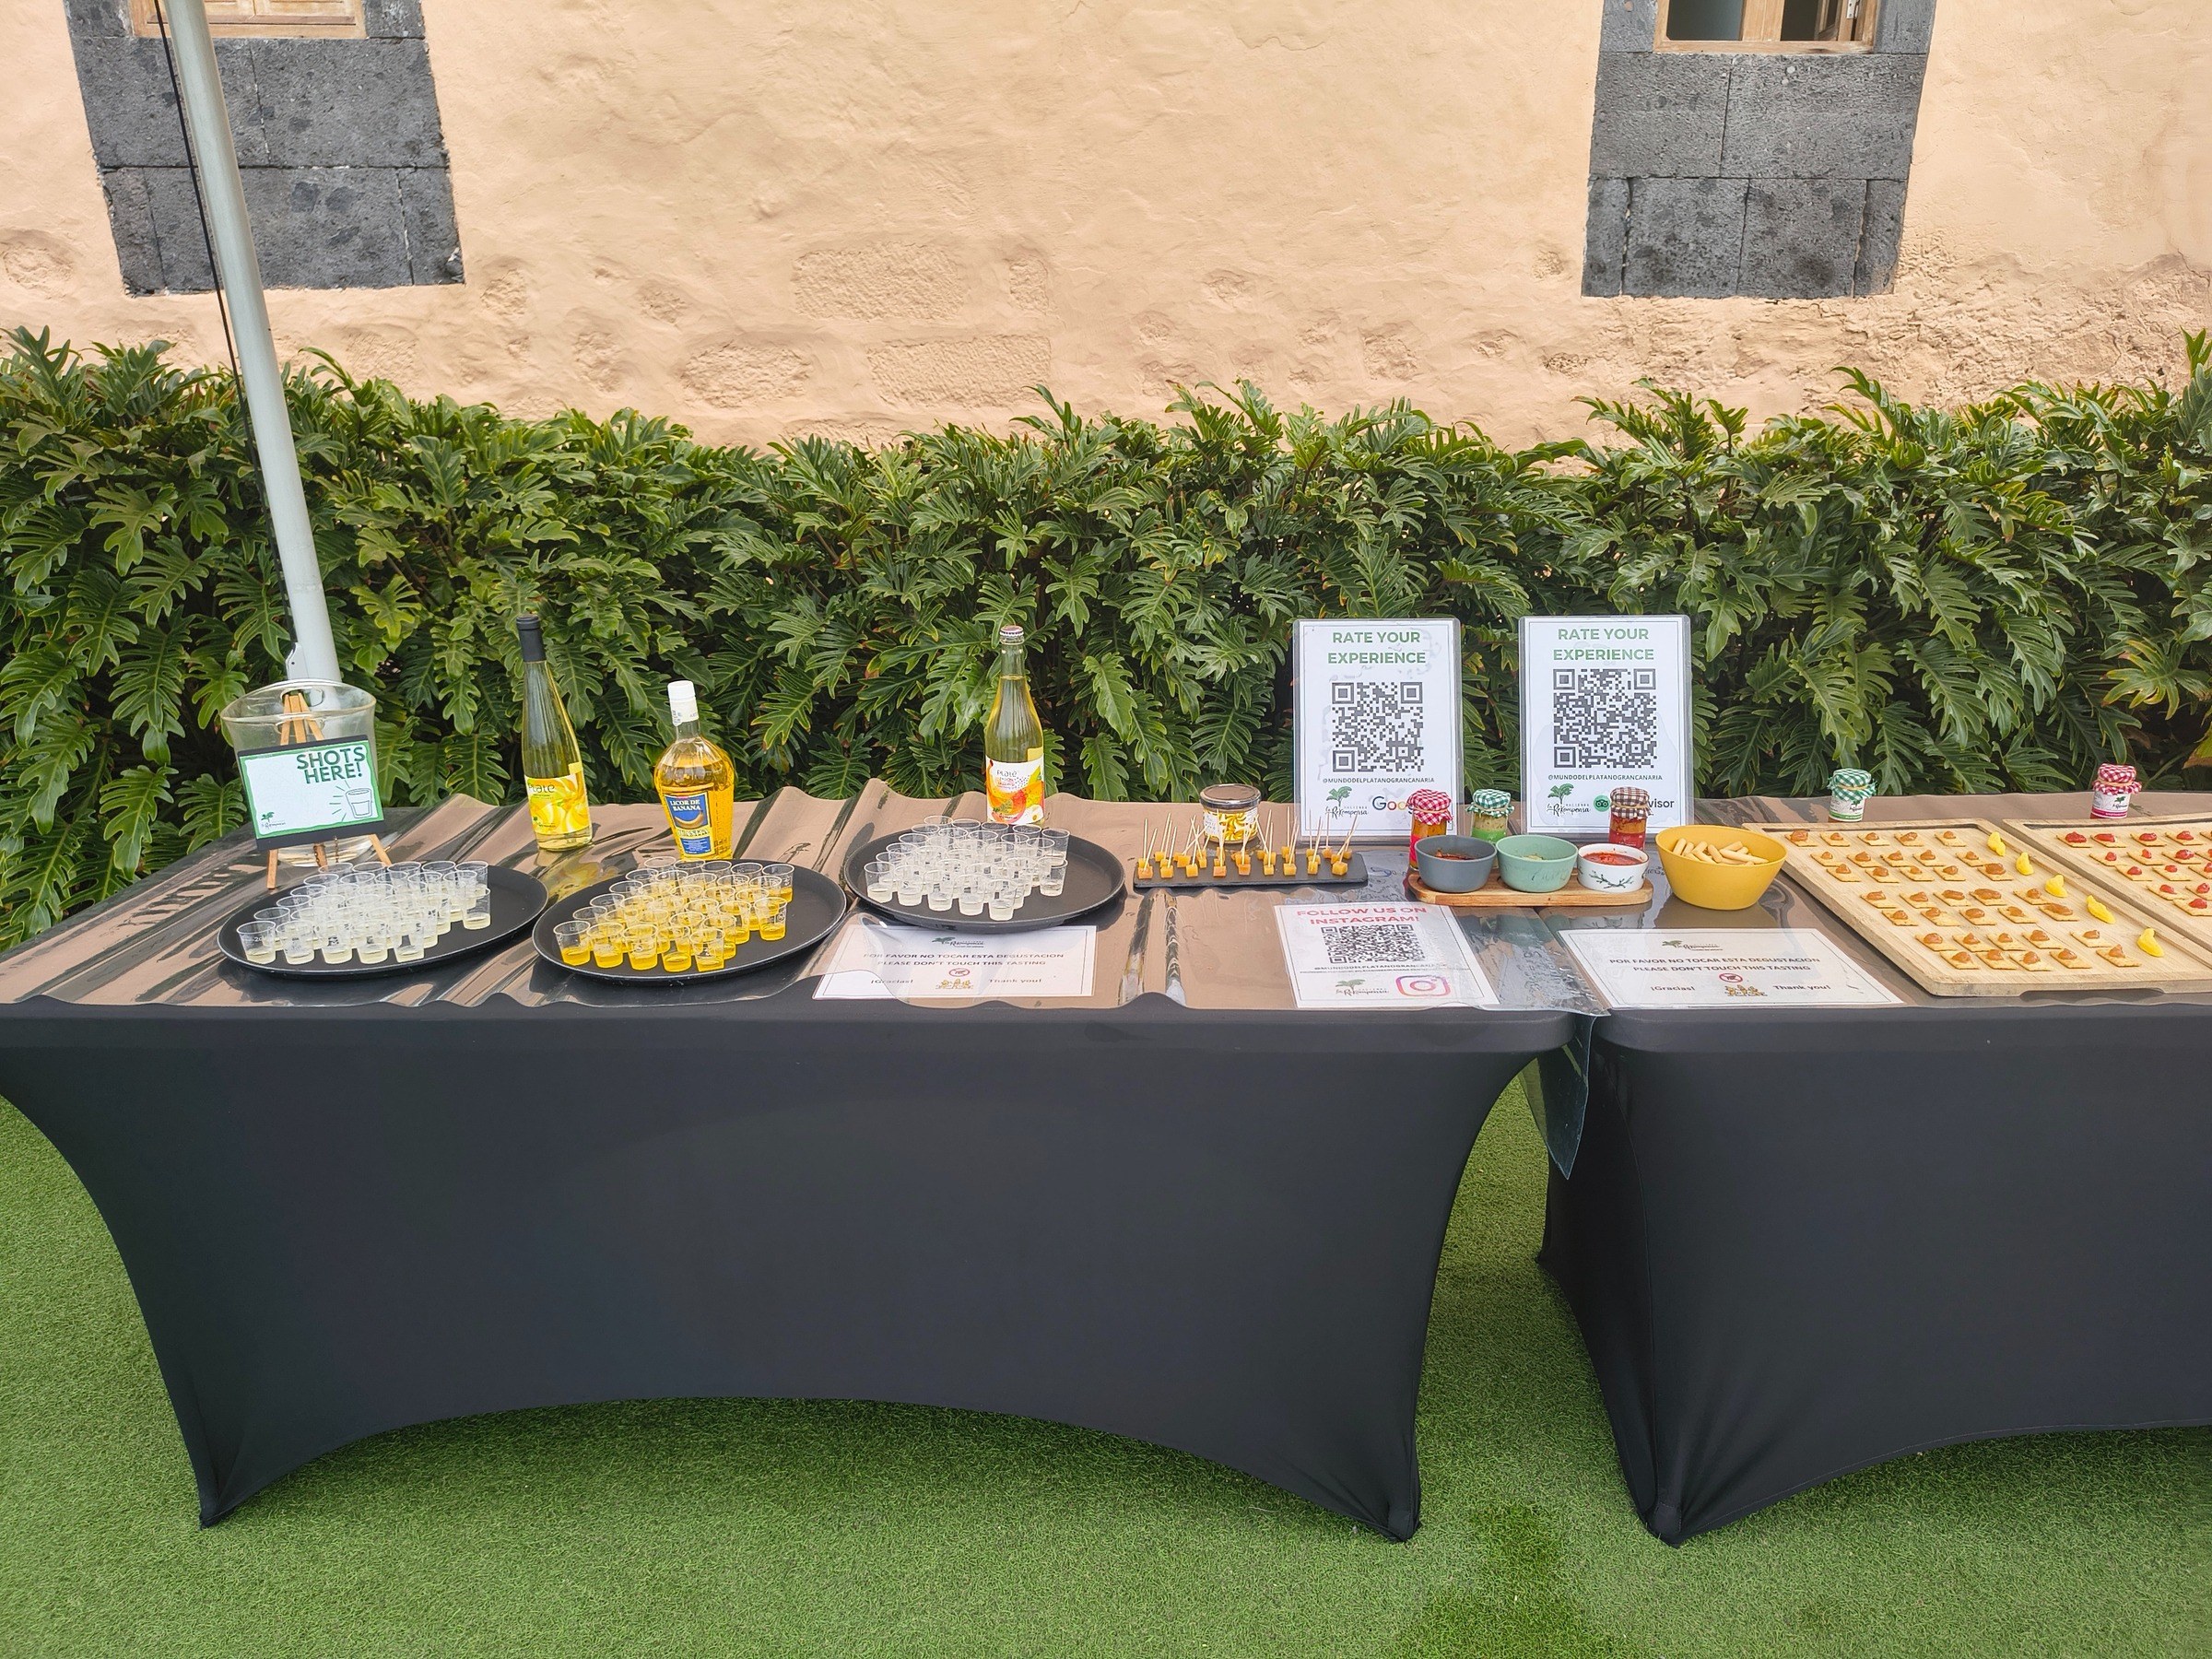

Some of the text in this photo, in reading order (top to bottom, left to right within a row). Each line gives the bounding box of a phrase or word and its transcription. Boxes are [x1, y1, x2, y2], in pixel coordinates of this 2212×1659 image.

[1332, 631, 1420, 643] RATE YOUR
[1558, 628, 1649, 640] RATE YOUR
[1327, 652, 1426, 665] EXPERIENCE
[1553, 649, 1654, 661] EXPERIENCE
[296, 747, 365, 770] SHOTS
[304, 761, 362, 784] HERE!
[1371, 795, 1413, 815] Goo
[1297, 908, 1369, 916] FOLLOW
[1310, 916, 1419, 924] INSTAGRAM!
